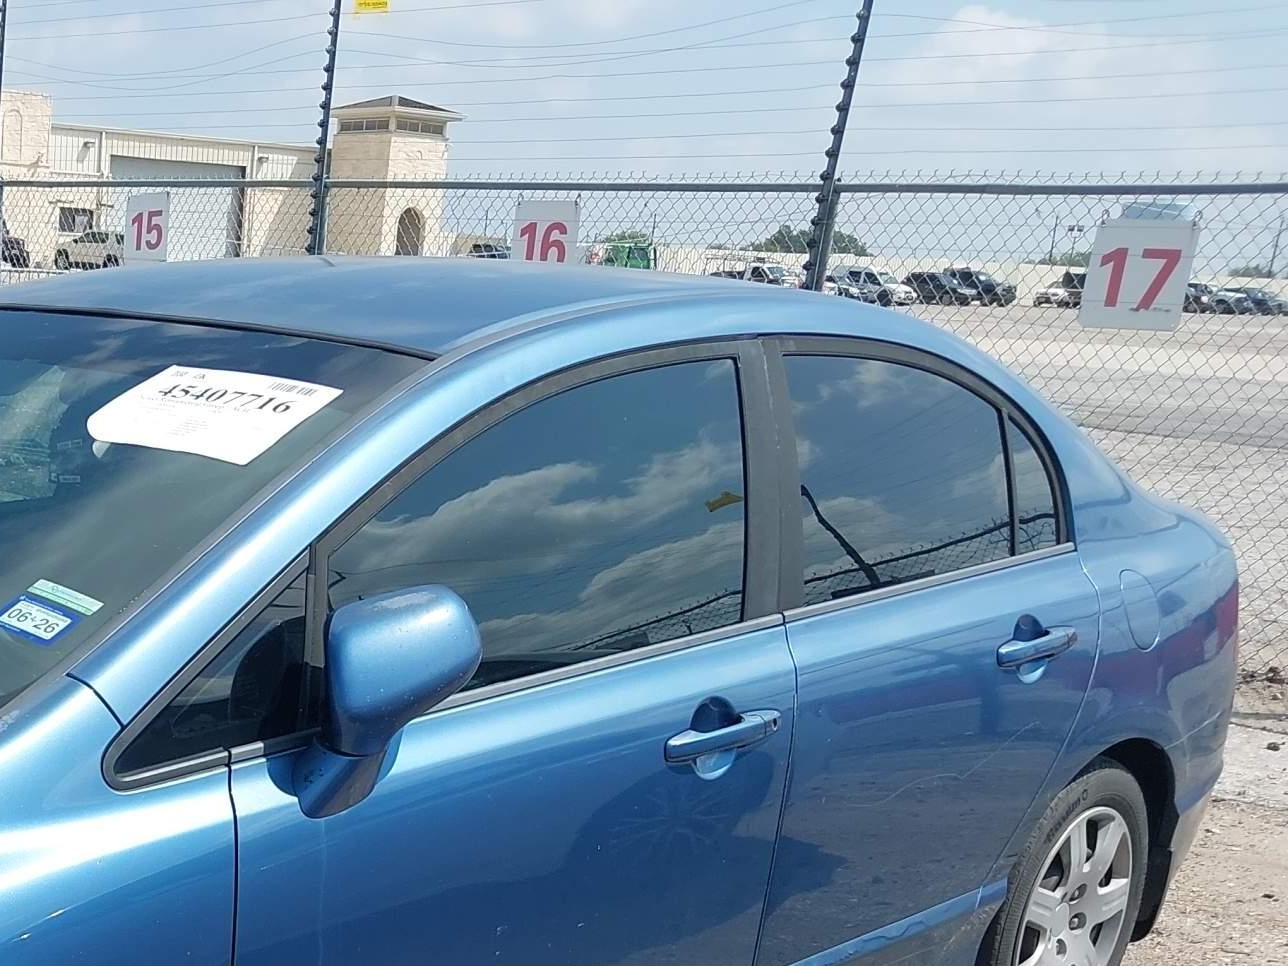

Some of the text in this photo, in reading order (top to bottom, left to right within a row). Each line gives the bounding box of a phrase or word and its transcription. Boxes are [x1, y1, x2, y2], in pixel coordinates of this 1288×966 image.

[131, 209, 164, 252] 15
[519, 221, 568, 263] 16
[1099, 247, 1183, 312] 17
[158, 383, 296, 414] 45407716
